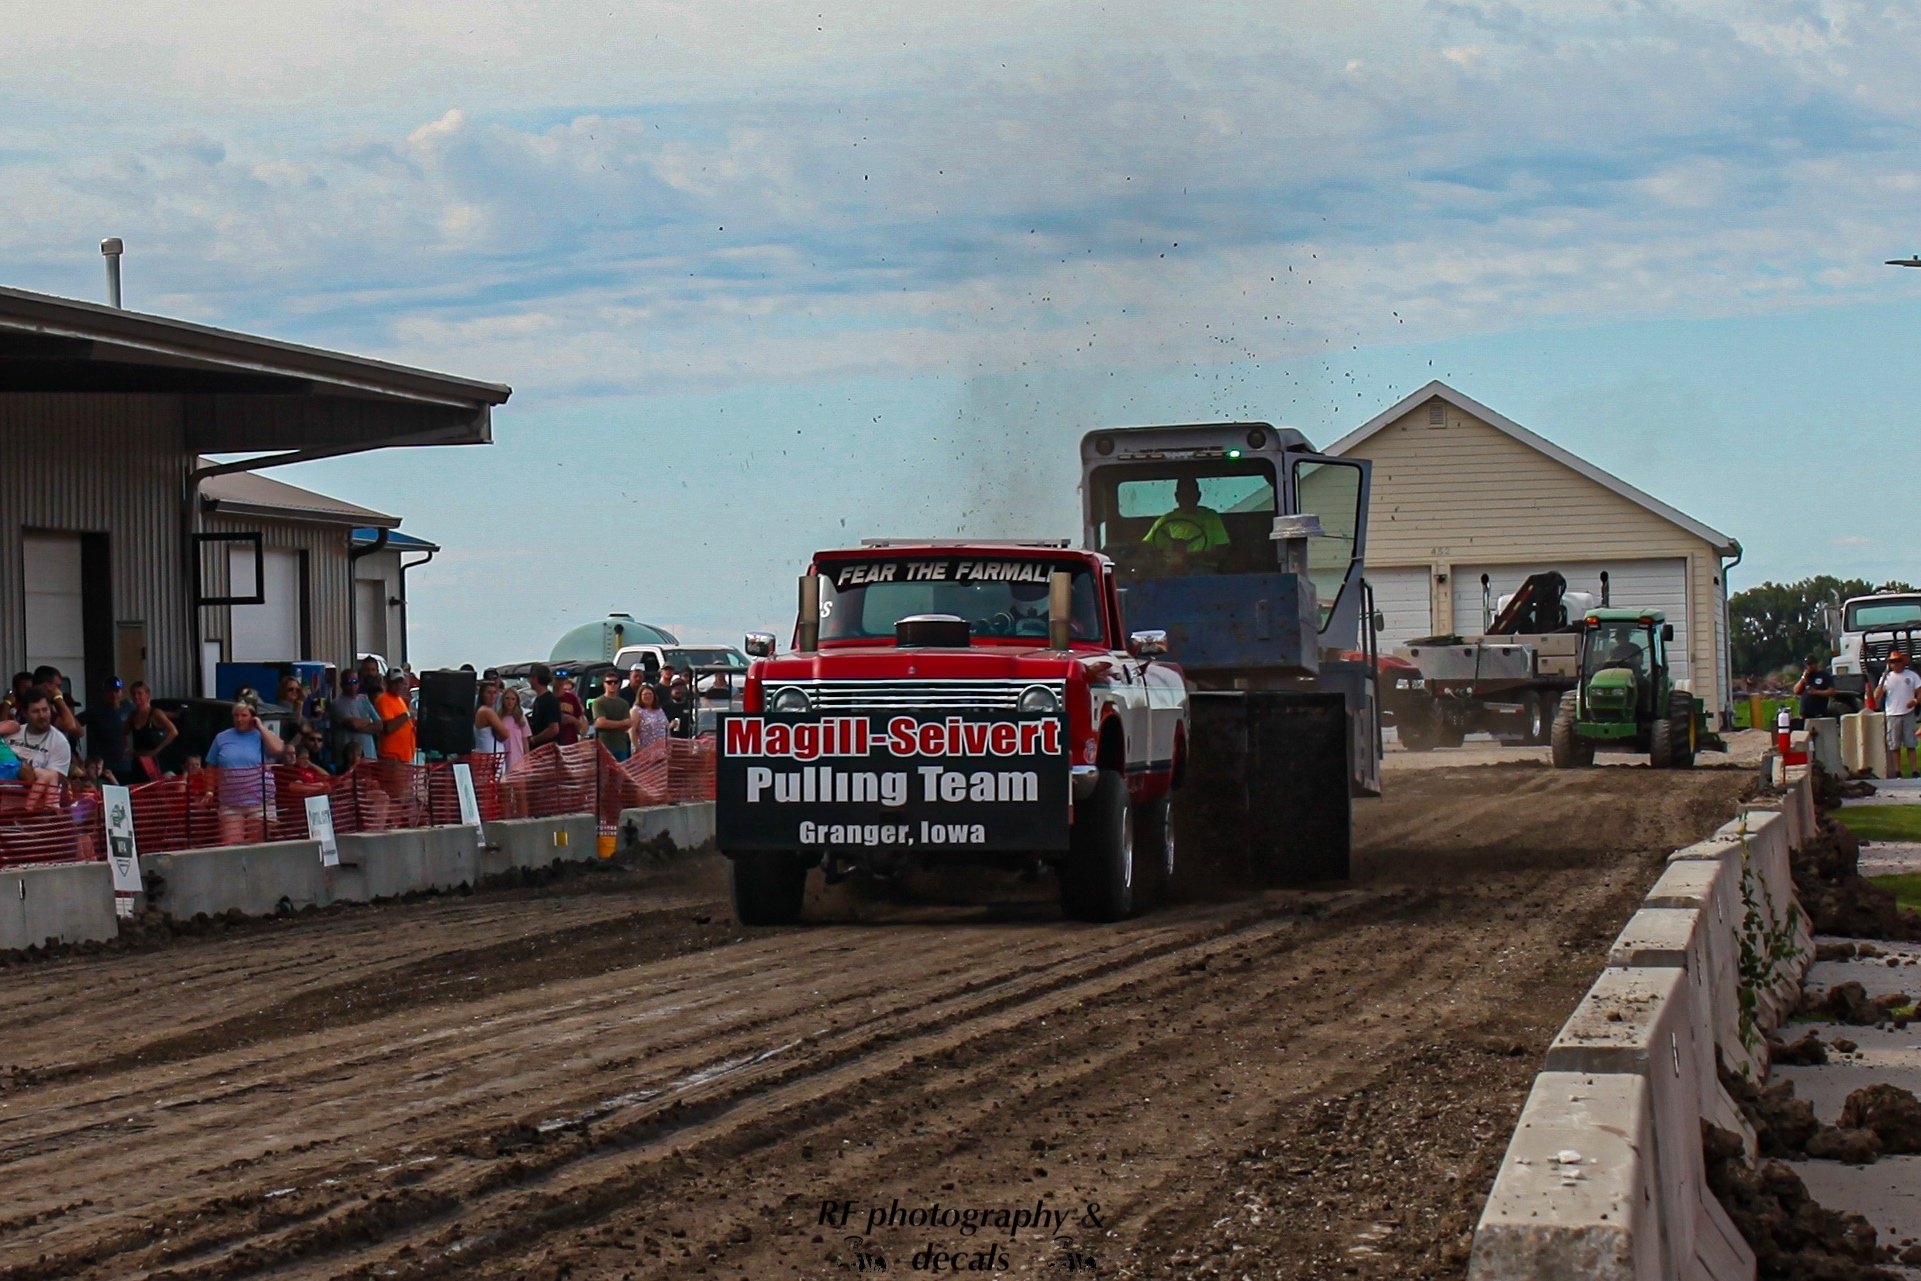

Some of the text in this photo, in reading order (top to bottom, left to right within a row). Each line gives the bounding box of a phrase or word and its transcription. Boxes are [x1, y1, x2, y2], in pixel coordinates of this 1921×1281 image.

[837, 563, 897, 586] FEAR
[906, 562, 950, 581] THE
[724, 716, 1062, 761] Magill-Seivert
[747, 766, 1039, 806] Pulling Team
[799, 821, 986, 846] Granger, Iowa
